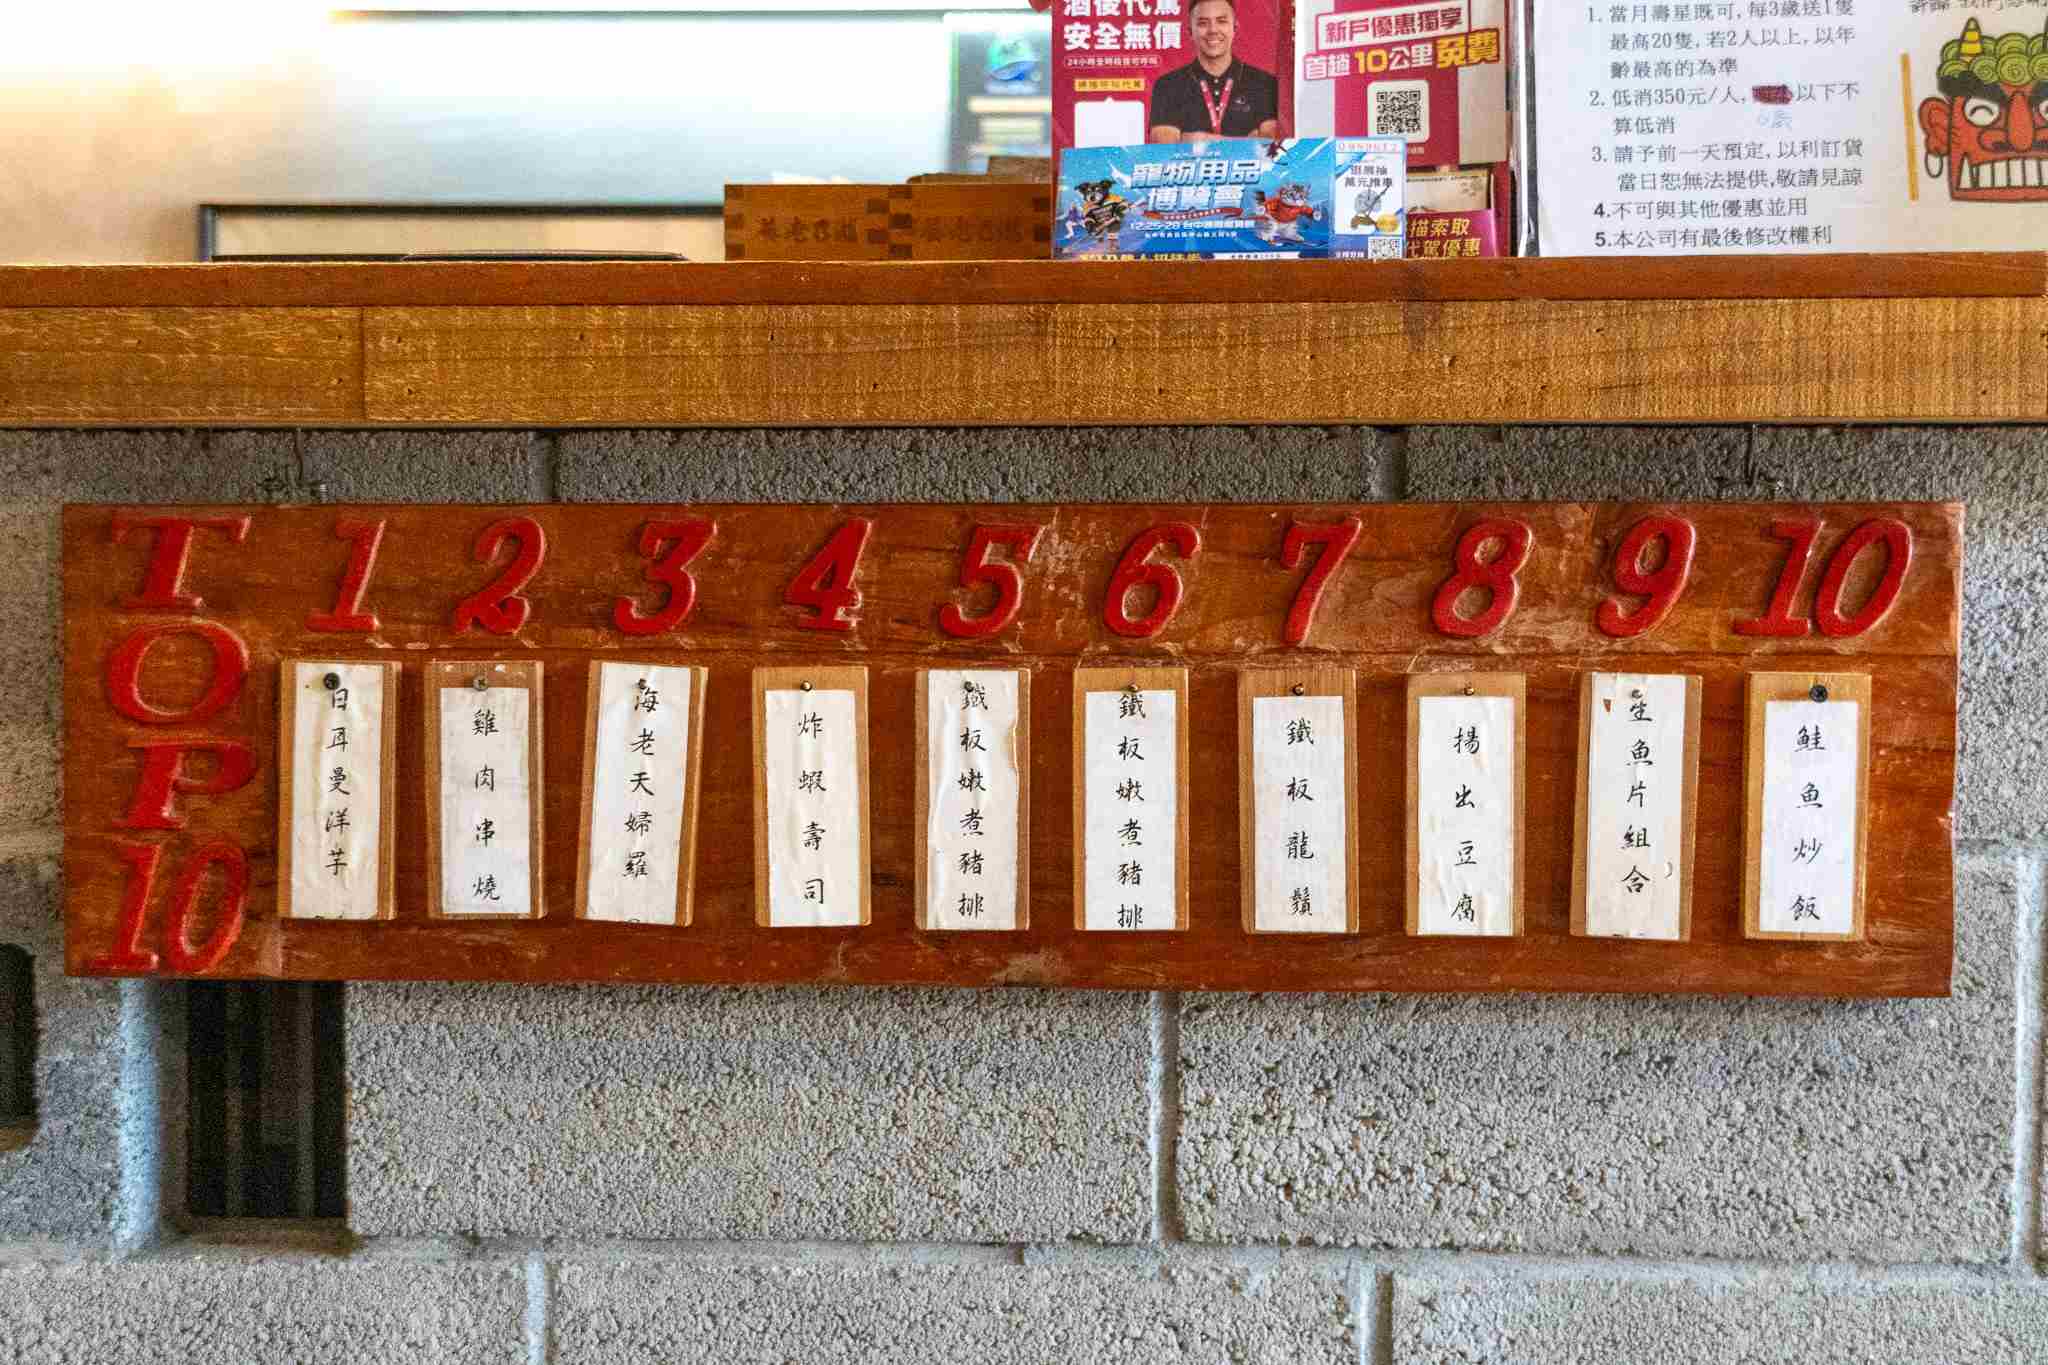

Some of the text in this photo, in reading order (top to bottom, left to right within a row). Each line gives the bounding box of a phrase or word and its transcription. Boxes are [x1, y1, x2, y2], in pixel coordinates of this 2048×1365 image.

[1063, 21, 1182, 50] 安全無價
[1326, 7, 1462, 43] 新戶優惠獨享
[1610, 58, 1737, 79] 齡最高的為準
[1589, 91, 1605, 107] 2.
[1592, 146, 1607, 162] 3.
[1613, 116, 1675, 135] 算低消
[1130, 160, 1262, 189] 寵物用品
[1148, 185, 1245, 212] 博覽會
[304, 519, 387, 632] 1
[453, 517, 546, 635] 2
[615, 519, 717, 637] 3
[784, 519, 873, 631] 4
[939, 524, 1045, 639] 5
[1104, 522, 1200, 639] 6
[1282, 518, 1362, 647] 7
[1432, 518, 1533, 638] 8
[1596, 516, 1696, 638] 9
[1733, 517, 1913, 639] 10
[84, 515, 257, 974] TOP 10
[323, 687, 352, 876] 日耳曼洋芋
[623, 686, 661, 878] 海老天婦羅
[957, 686, 988, 918] 鐵板嫩煮豬排
[1620, 691, 1653, 896] 生魚片組合
[472, 709, 501, 902] 雞肉串燒
[798, 713, 827, 906] 炸蝦壽司
[1118, 693, 1146, 930] 鐵板嫩煮豬排
[1286, 719, 1316, 919] 鐵板龍鬚
[1453, 726, 1481, 923] 揚出豆腐
[1792, 725, 1826, 922] 鮭魚炒飯
